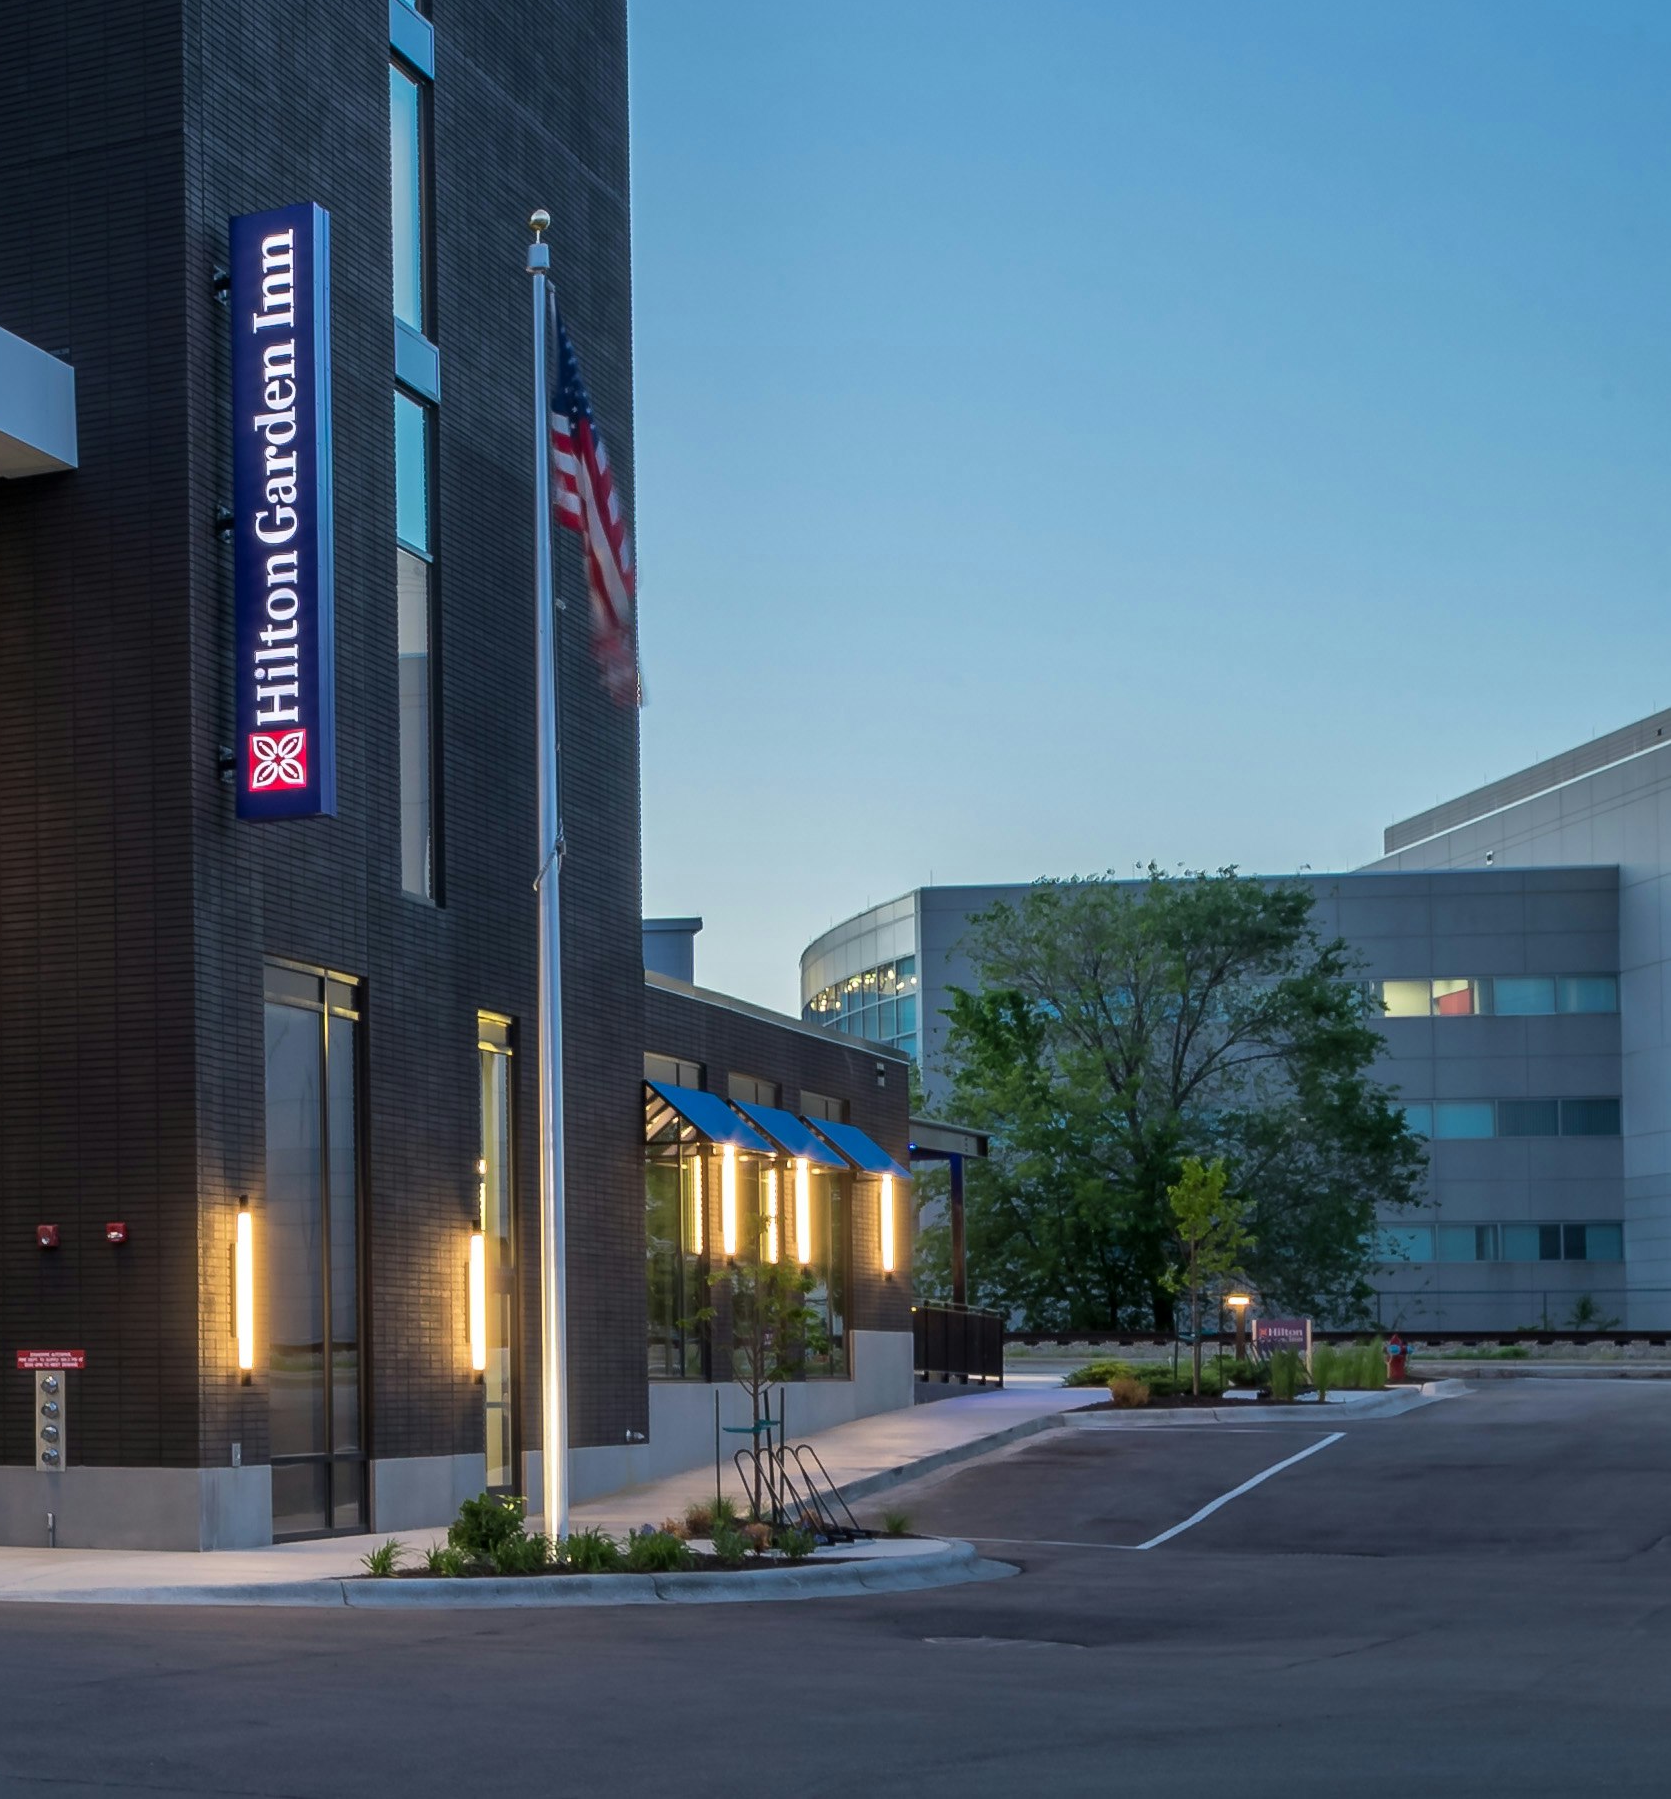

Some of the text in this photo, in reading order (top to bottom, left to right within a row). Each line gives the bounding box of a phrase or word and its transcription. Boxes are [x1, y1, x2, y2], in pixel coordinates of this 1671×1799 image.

[252, 228, 300, 726] Hilton Garden Inn
[1268, 1327, 1303, 1337] Hilton
